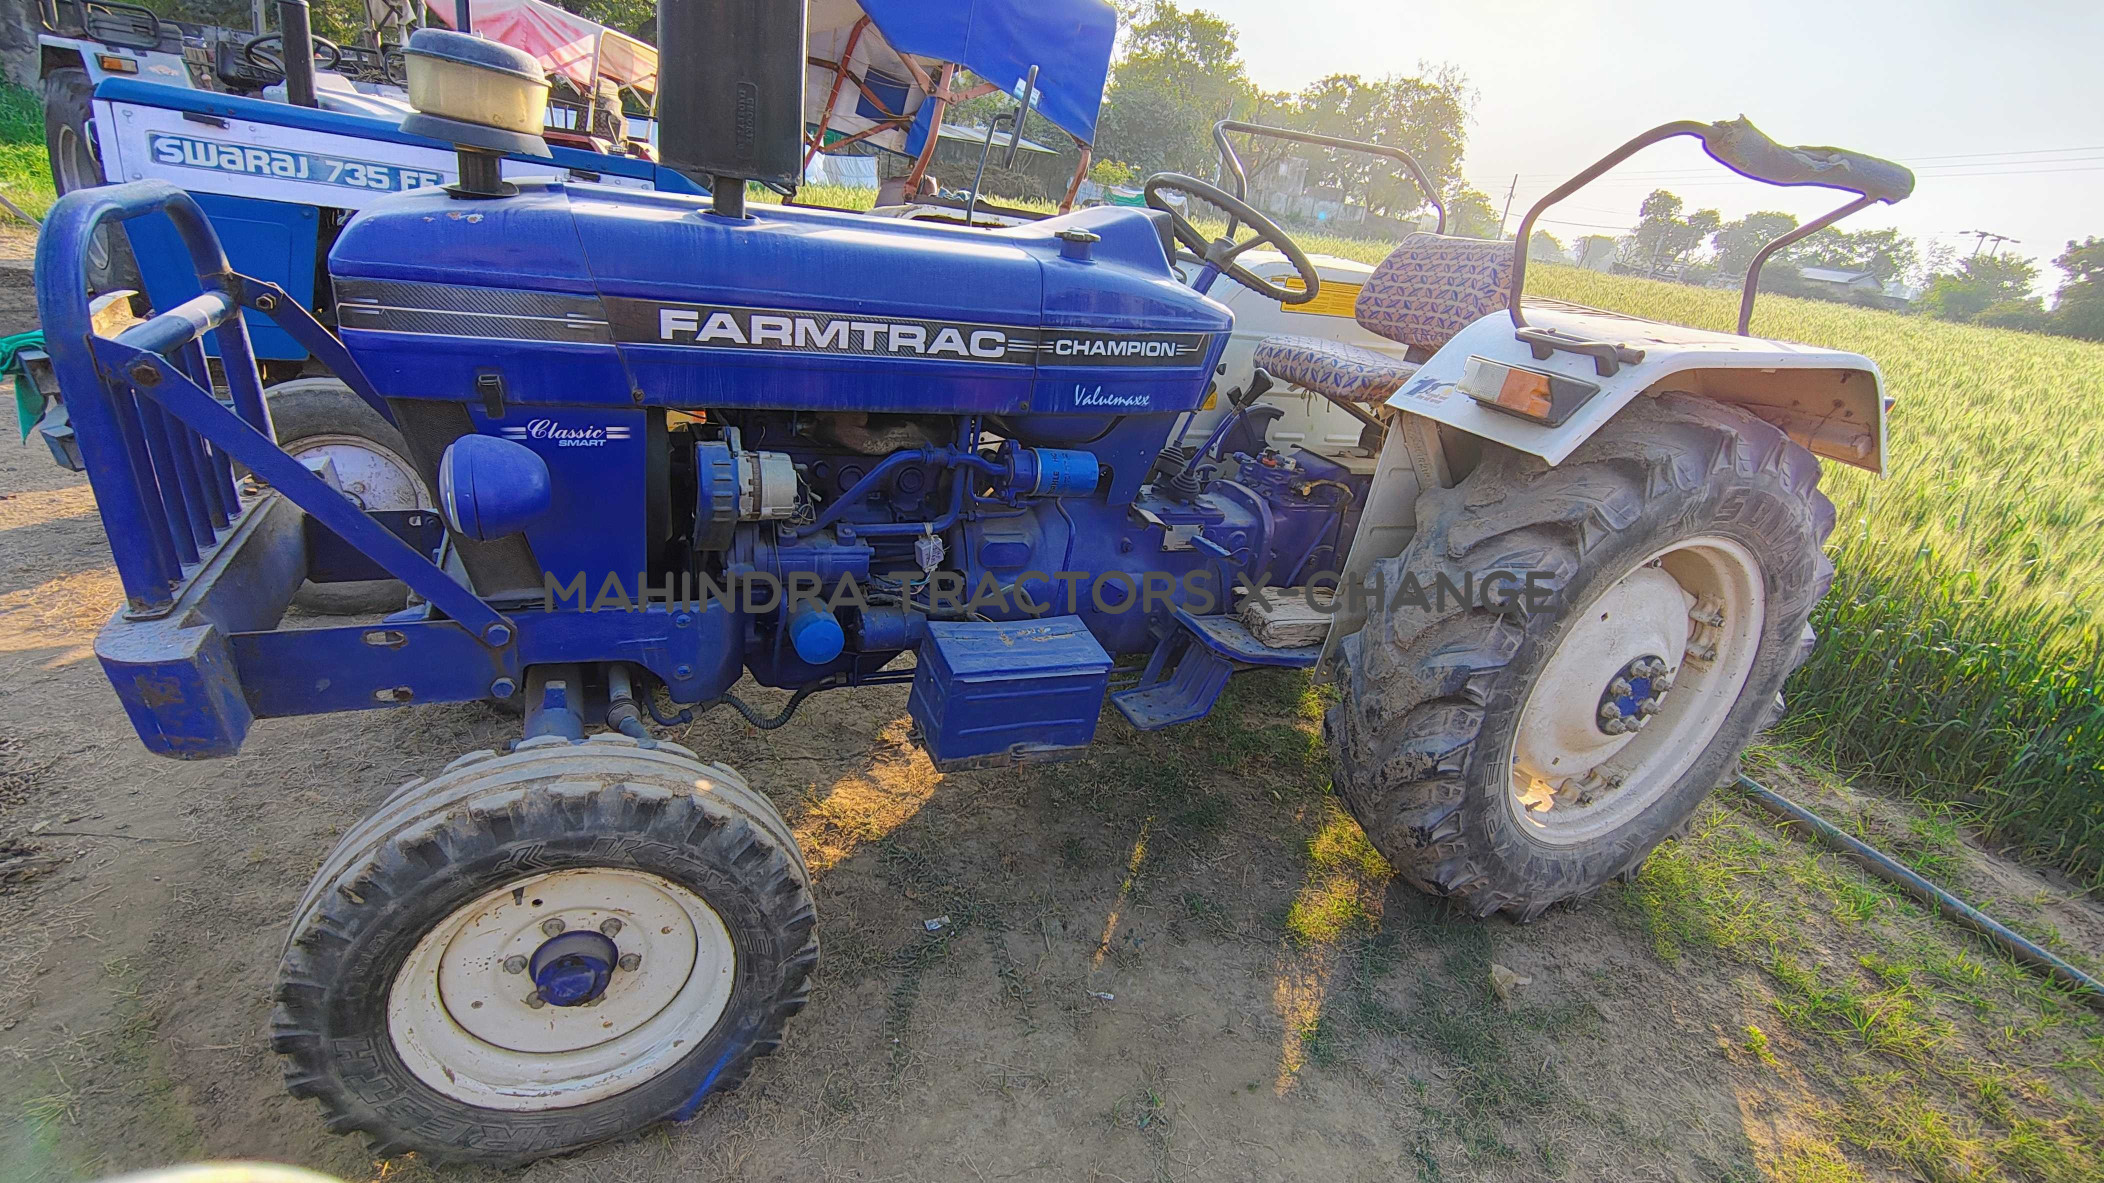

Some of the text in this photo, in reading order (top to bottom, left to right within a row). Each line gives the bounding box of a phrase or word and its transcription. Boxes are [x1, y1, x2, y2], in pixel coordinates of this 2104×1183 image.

[325, 160, 390, 191] 735
[658, 308, 1006, 358] FARMTRAC
[1055, 339, 1176, 357] CHAMPION
[1074, 384, 1150, 407] Valuemaxx
[527, 419, 606, 439] Classic
[558, 439, 606, 447] SMART
